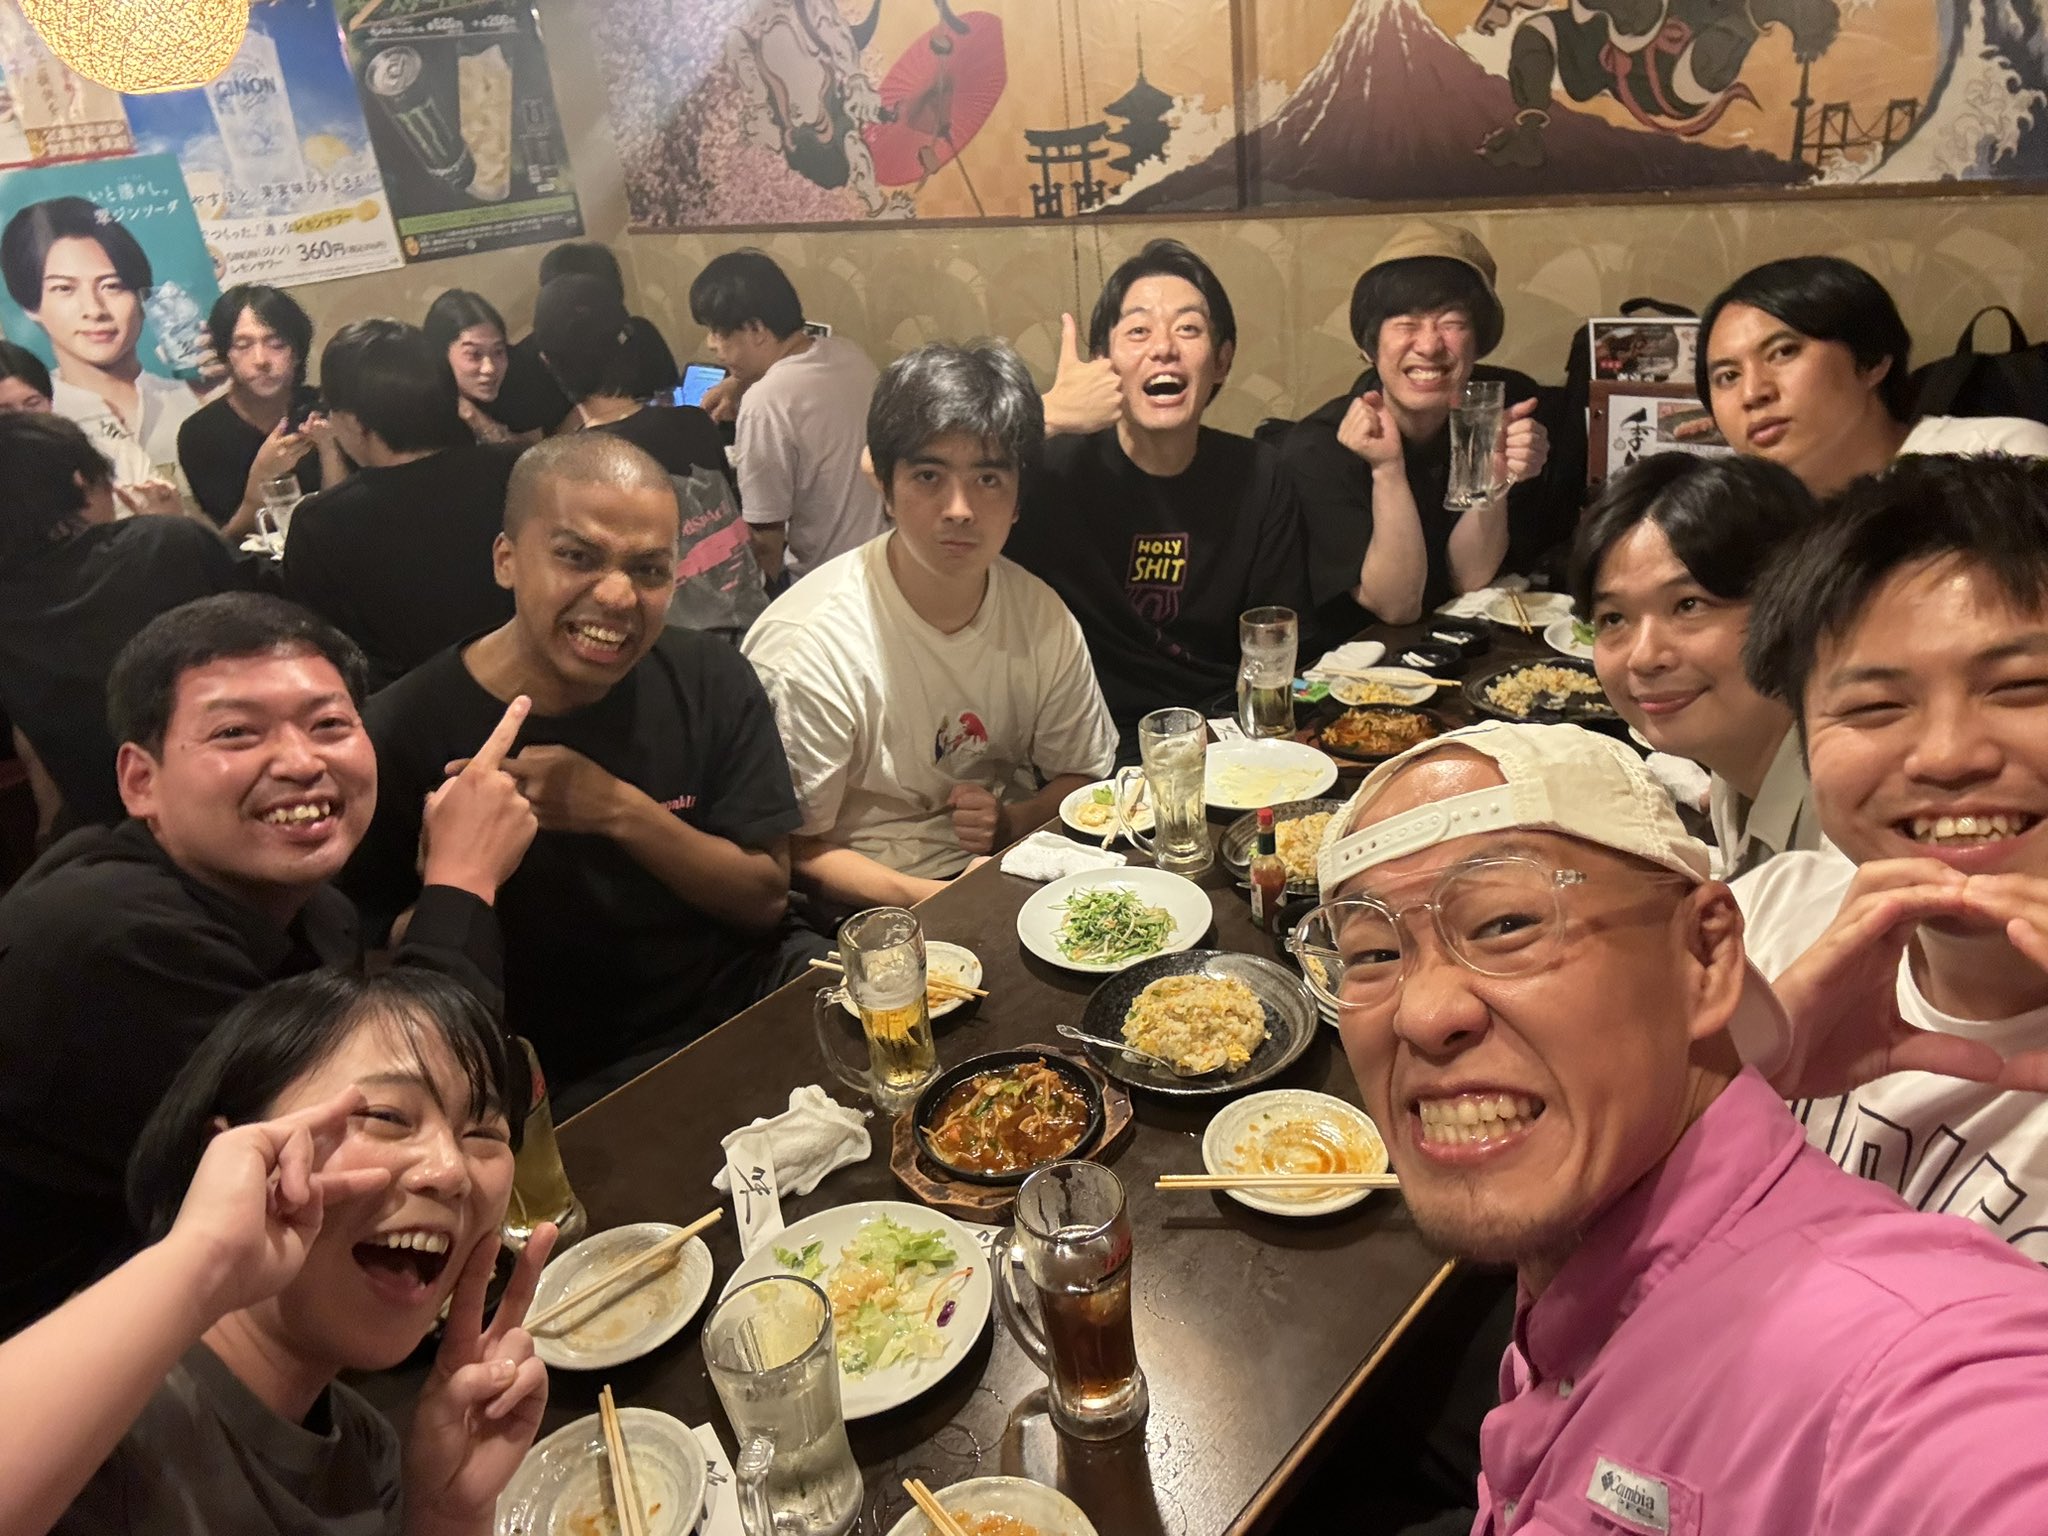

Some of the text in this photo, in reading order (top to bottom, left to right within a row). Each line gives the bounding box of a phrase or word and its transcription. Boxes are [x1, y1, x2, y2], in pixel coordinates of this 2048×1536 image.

[1138, 540, 1182, 556] HOLY
[1131, 557, 1186, 582] SHIT
[1611, 1474, 1655, 1511] Combia
